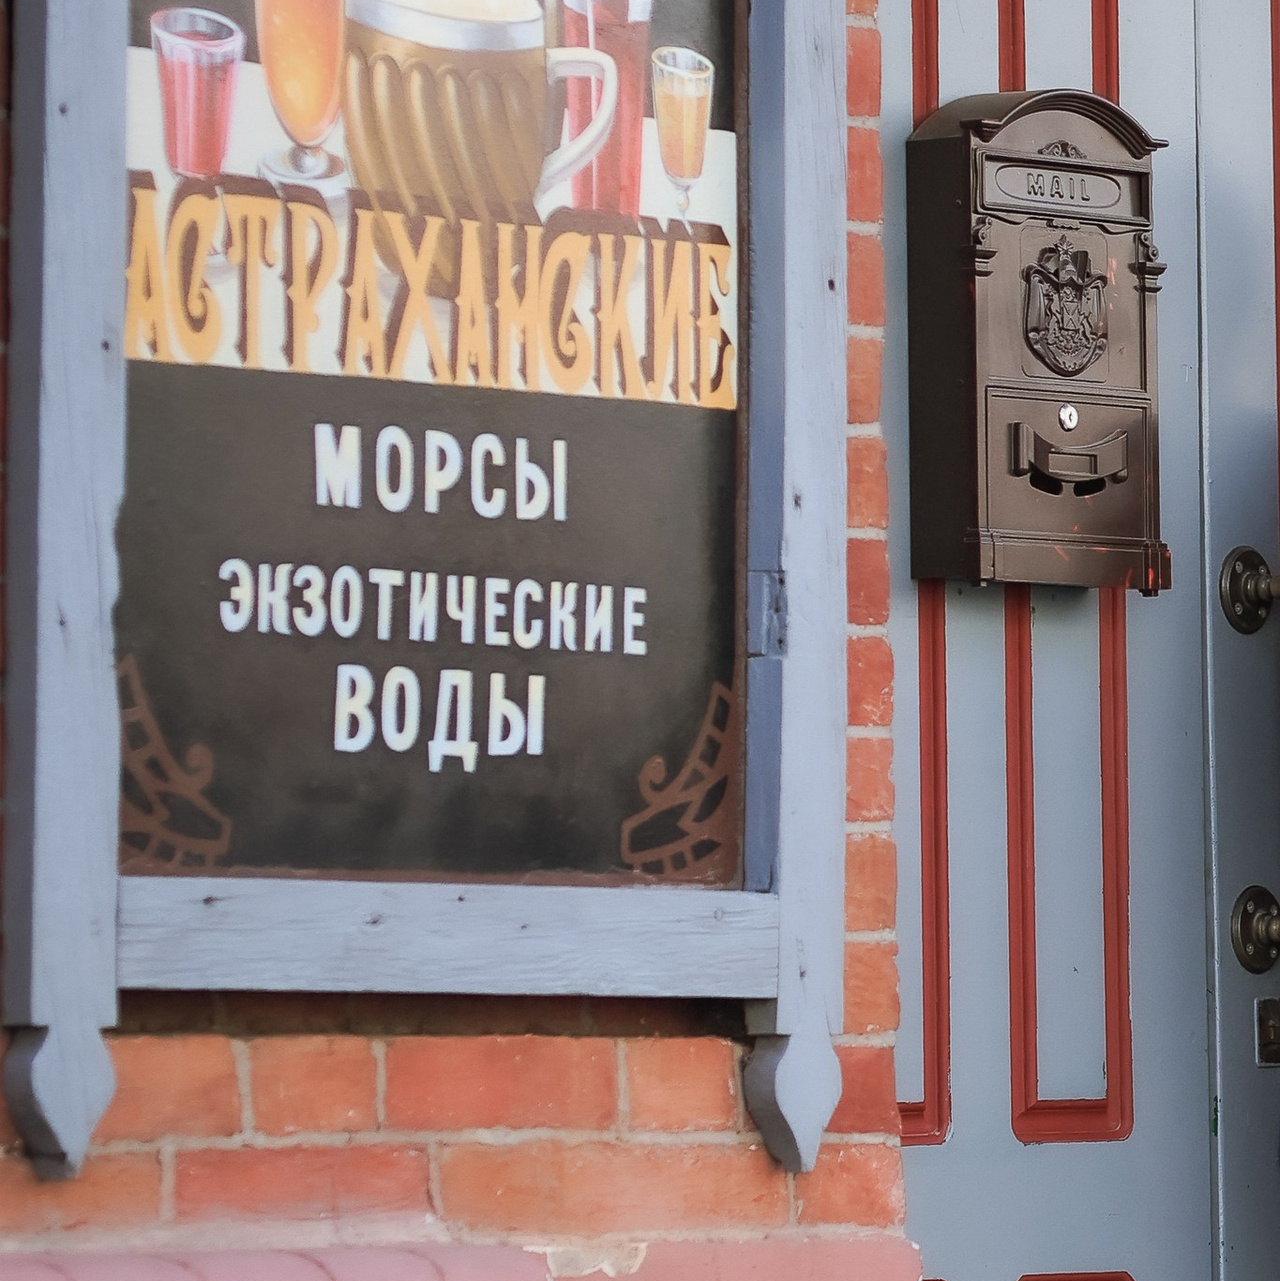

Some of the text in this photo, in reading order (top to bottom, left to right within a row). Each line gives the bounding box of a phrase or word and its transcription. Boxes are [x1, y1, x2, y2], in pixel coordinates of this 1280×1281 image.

[1026, 172, 1092, 202] MAIL
[124, 170, 737, 410] АСТРАХАНСКИЕ
[314, 422, 568, 522] МОРСЫ
[218, 557, 648, 656] ЭКЗОТИЧЕСКИЕ
[333, 663, 546, 773] ВОДЫ
